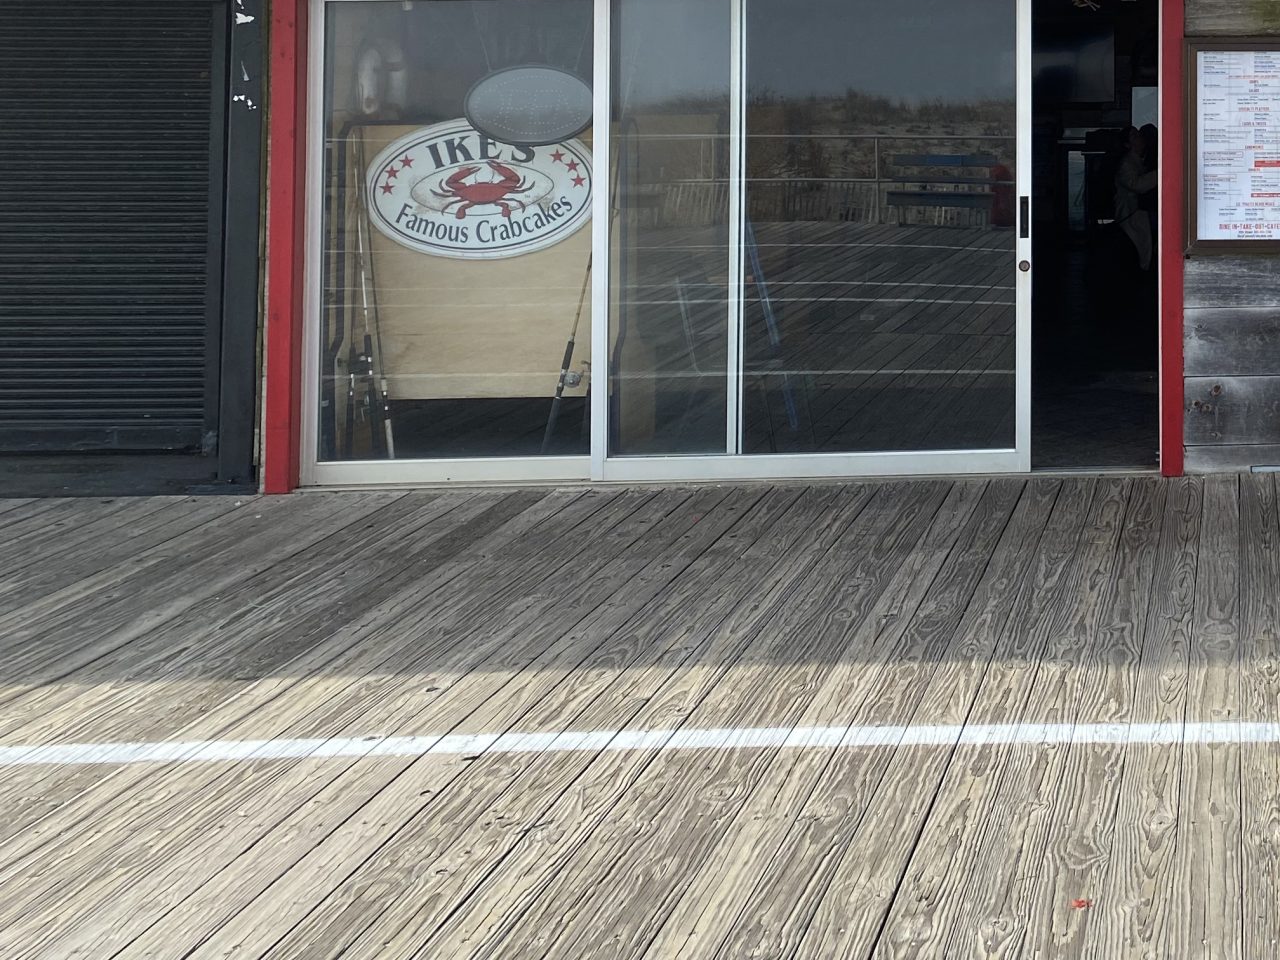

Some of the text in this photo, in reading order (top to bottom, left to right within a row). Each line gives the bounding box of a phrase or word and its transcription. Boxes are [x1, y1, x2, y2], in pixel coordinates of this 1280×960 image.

[426, 134, 536, 170] IKES
[394, 195, 573, 244] Famous Crabcakes
